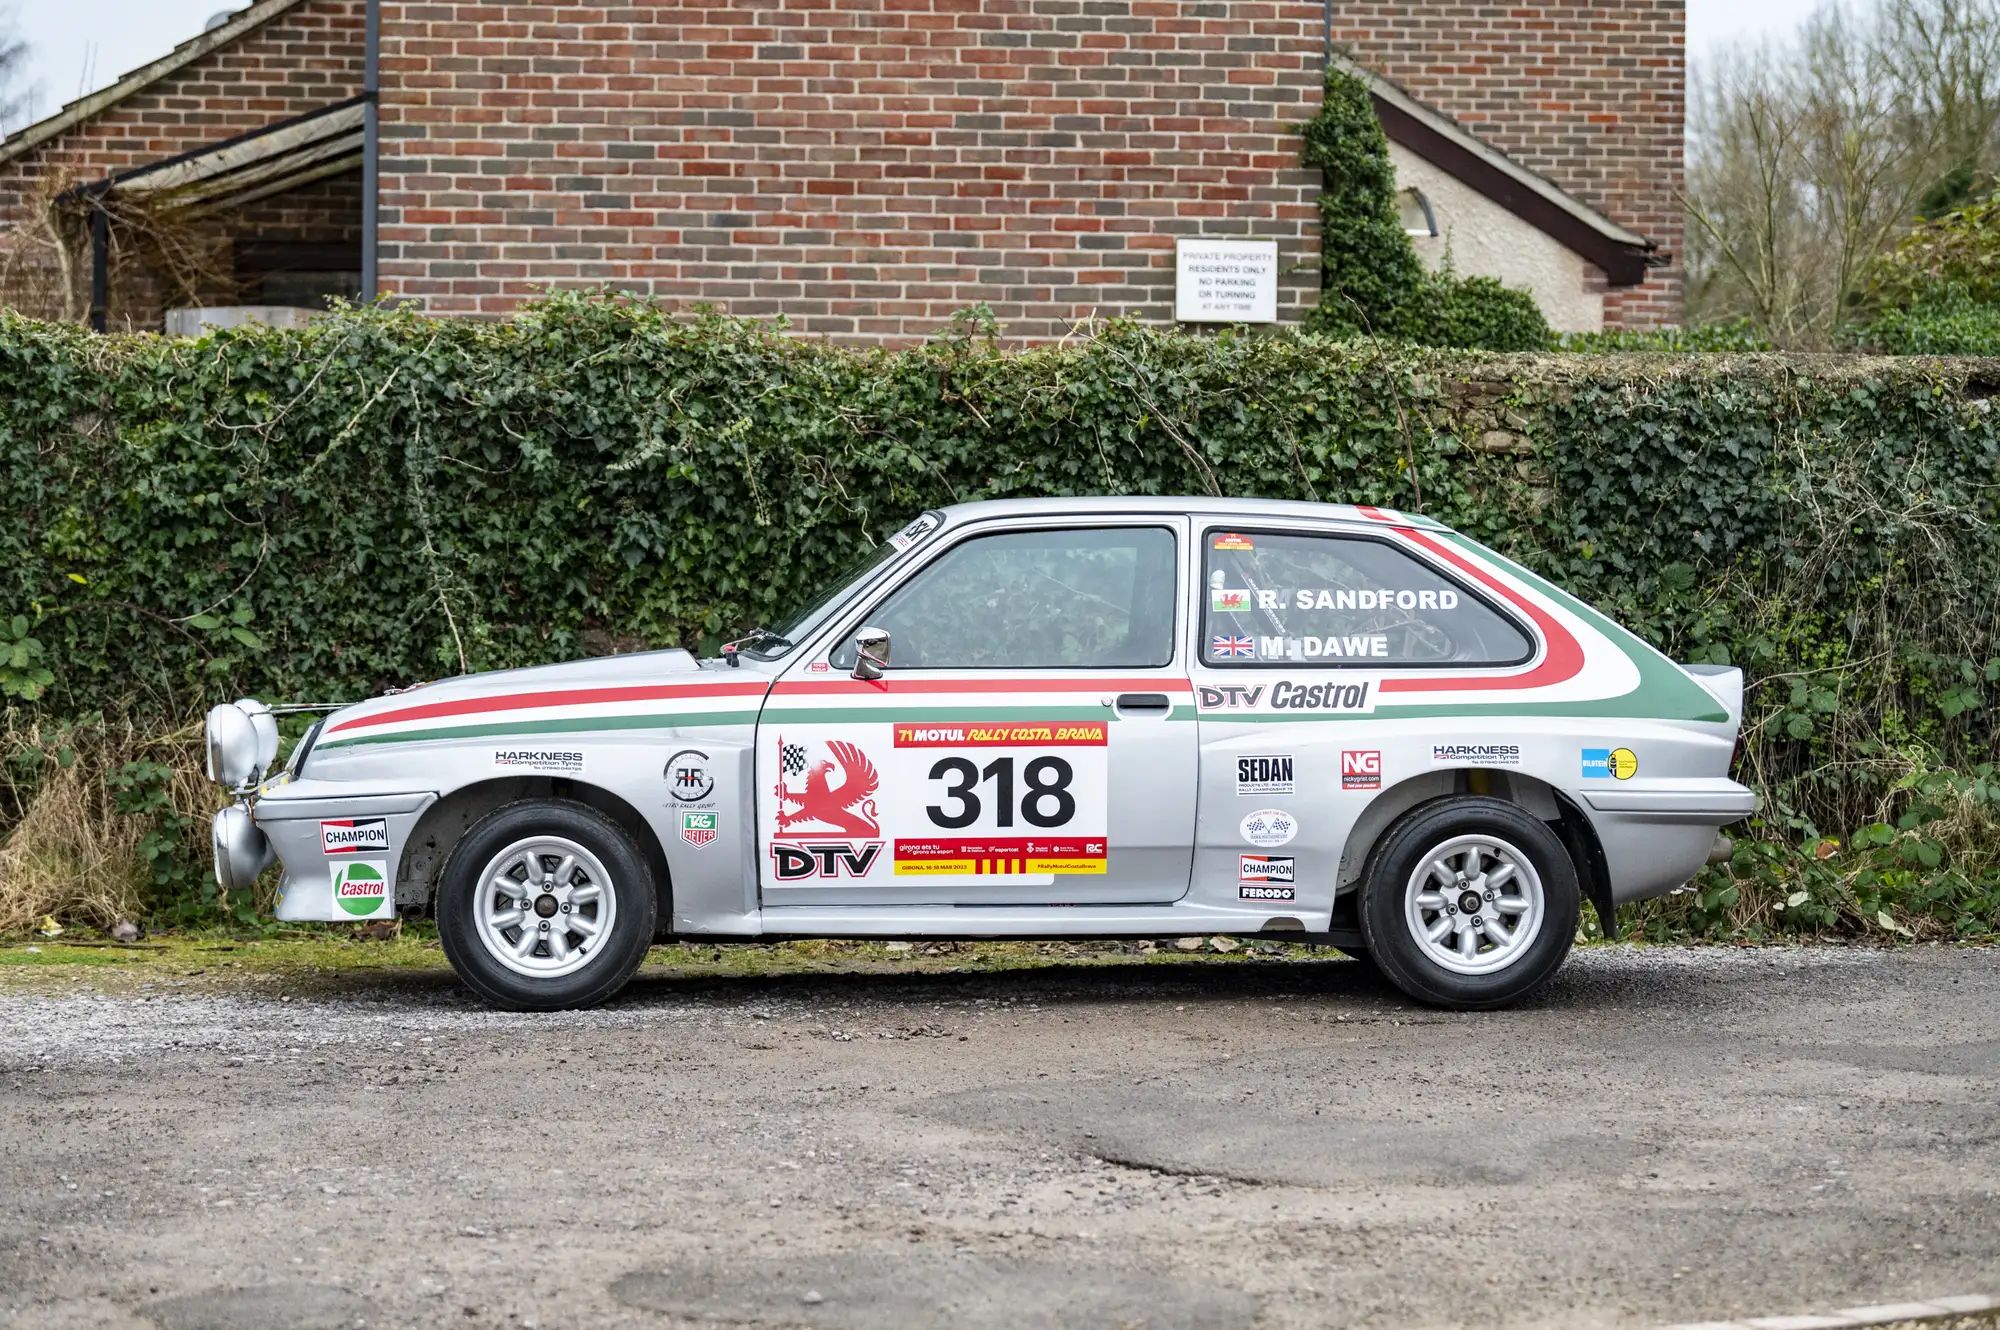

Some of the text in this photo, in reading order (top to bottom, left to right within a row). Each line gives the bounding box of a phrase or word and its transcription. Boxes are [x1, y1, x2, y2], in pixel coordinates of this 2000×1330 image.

[1183, 251, 1273, 261] PRIVATE PROPERTY
[1188, 264, 1267, 274] RESIDENTS ONLY
[1199, 278, 1257, 287] NO PARKING
[1198, 290, 1257, 299] OR TURNING
[1234, 303, 1252, 311] TIME
[1259, 590, 1458, 609] R. SANDFORD
[1261, 636, 1388, 656] M. DAWE
[1198, 681, 1369, 709] DTV Castrol
[898, 727, 1104, 741] 71 MOTUL RALLY COSTA BRAVA
[496, 751, 583, 761] HARKNESS
[1434, 745, 1519, 754] HARKNESS
[1343, 752, 1379, 774] NG
[1238, 758, 1293, 782] SEDAN
[926, 756, 1076, 829] 318
[688, 815, 712, 828] TAG
[325, 829, 385, 843] CHAMPION
[685, 830, 715, 844] HEUER
[771, 842, 885, 880] DTV
[1243, 863, 1292, 875] CHAMPION
[341, 882, 384, 895] Castrol
[1242, 888, 1292, 898] FERODO
